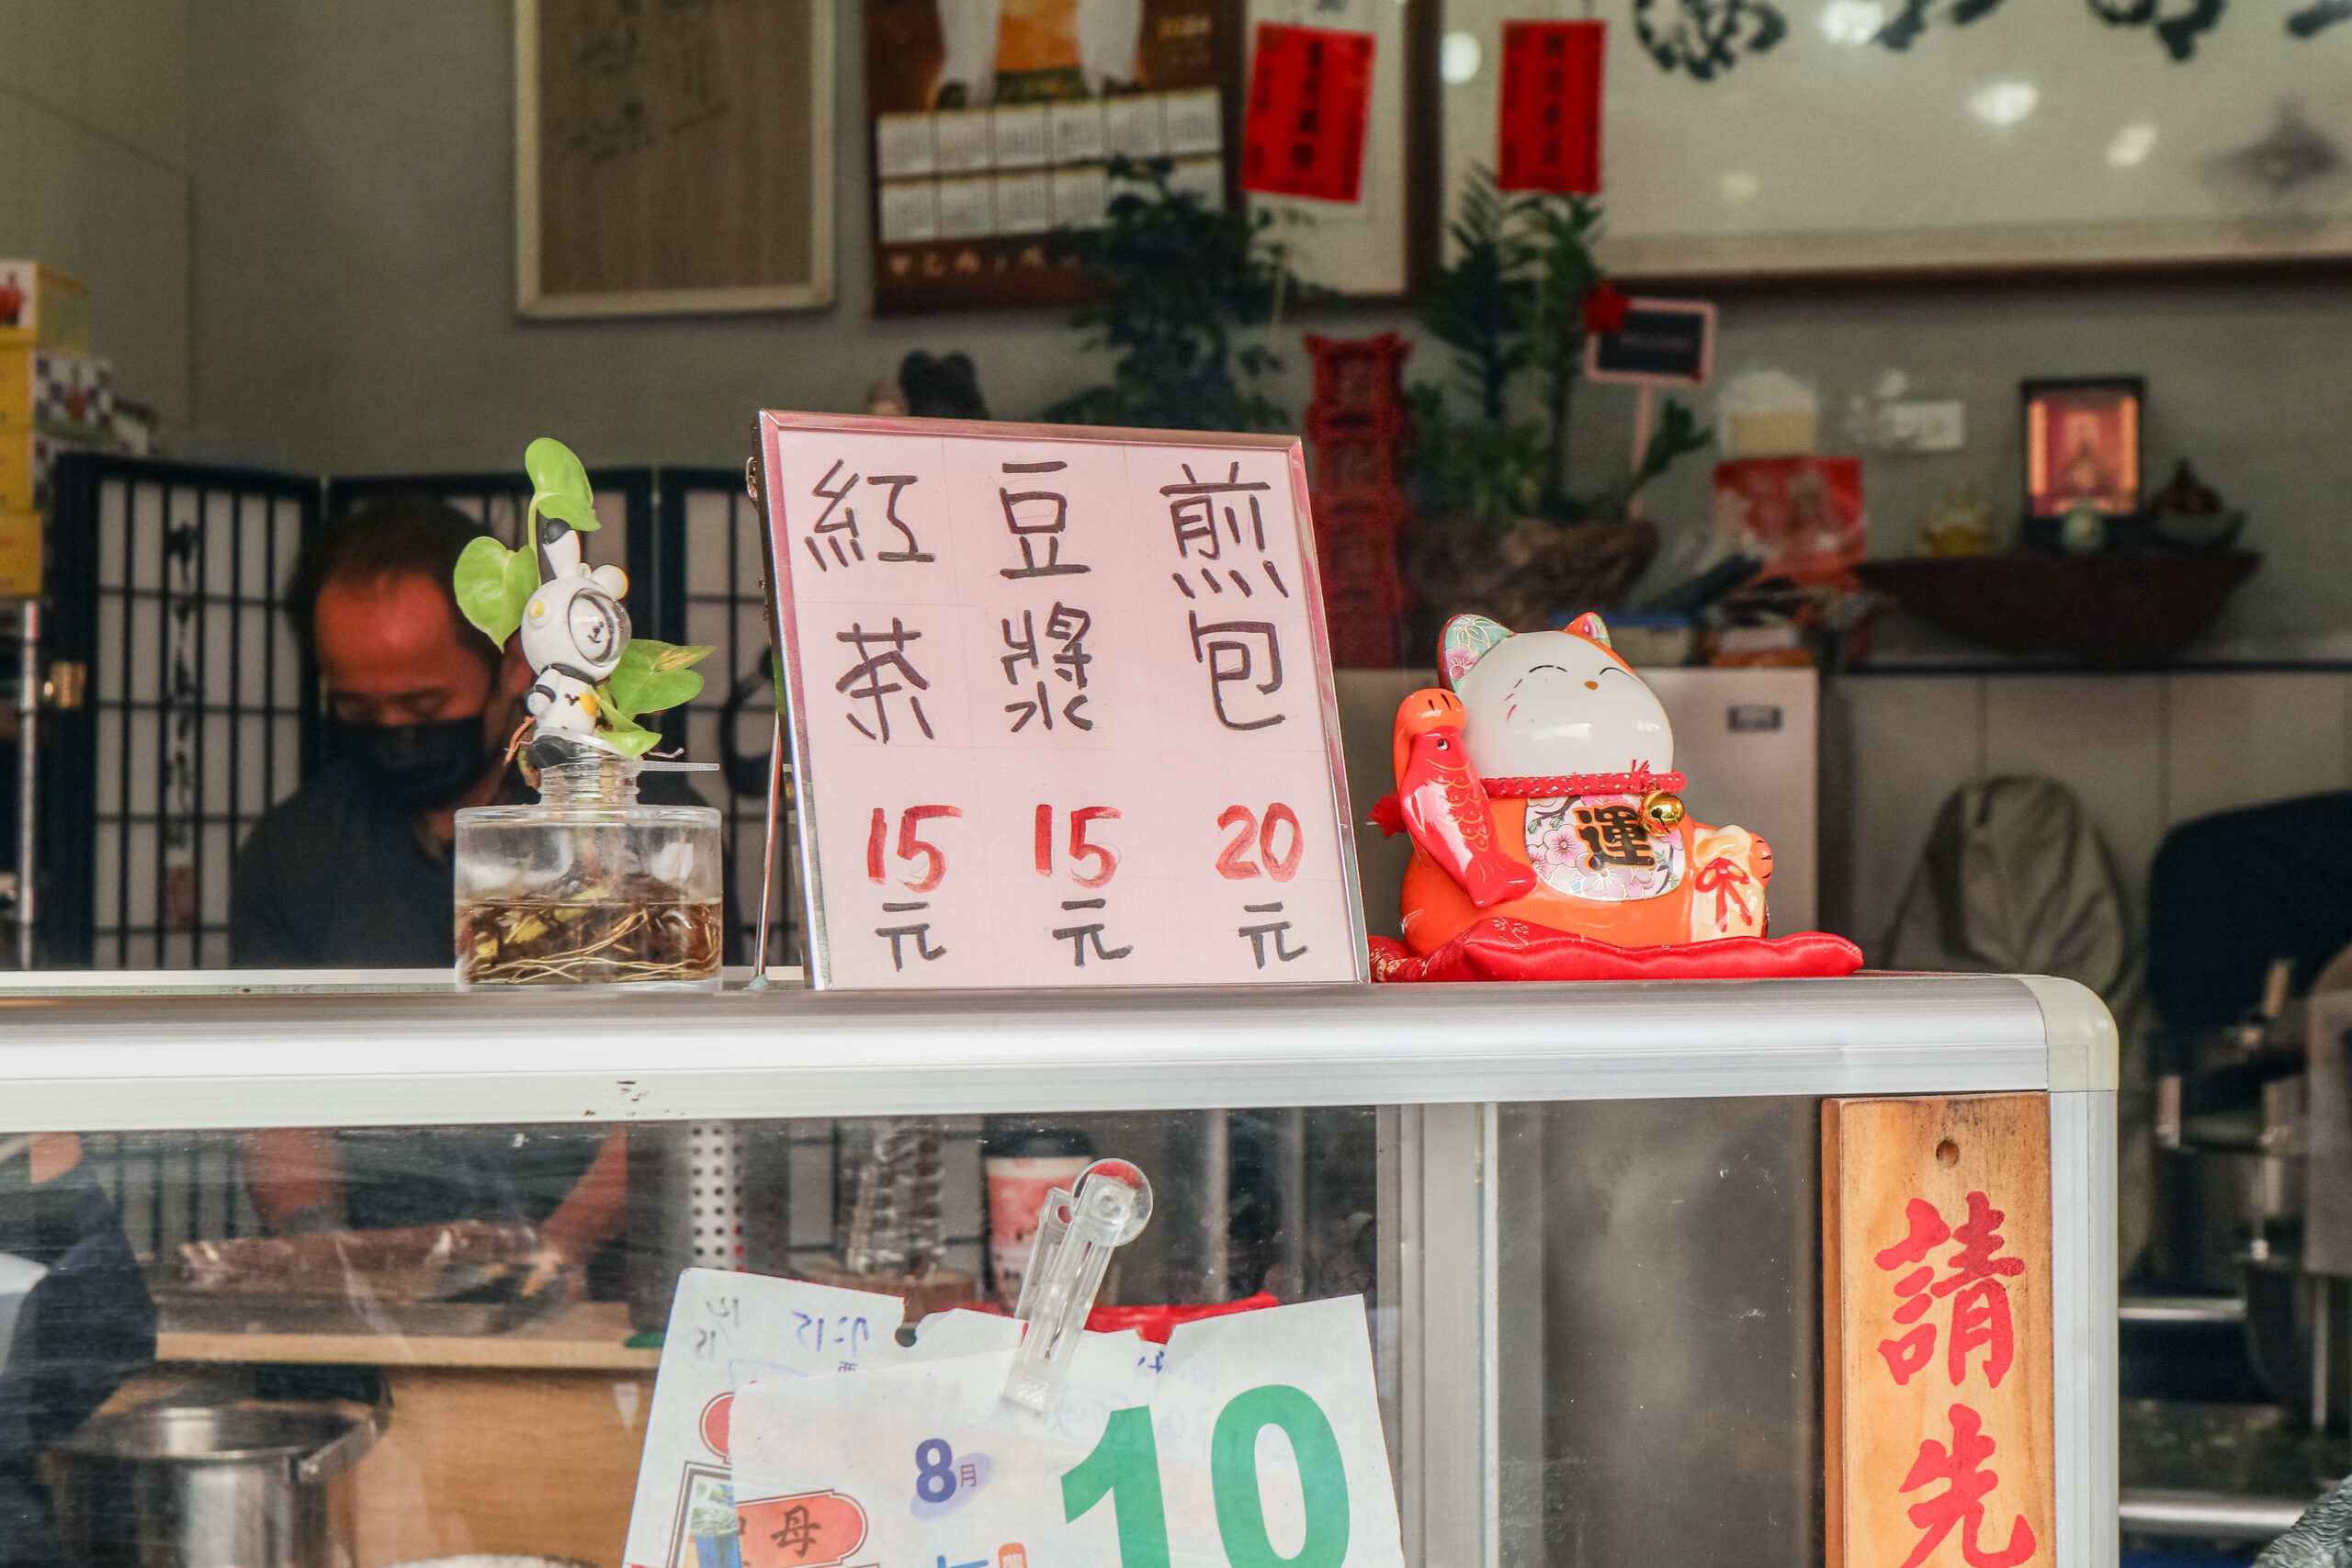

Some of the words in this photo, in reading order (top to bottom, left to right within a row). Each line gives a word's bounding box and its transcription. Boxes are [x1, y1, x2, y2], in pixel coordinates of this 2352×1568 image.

[805, 459, 935, 743] 紅茶
[999, 461, 1092, 731] 豆漿
[1159, 461, 1289, 731] 煎包
[1576, 805, 1656, 871] 運
[1060, 1383, 1351, 1568] 10
[1873, 1190, 2037, 1568] 請先
